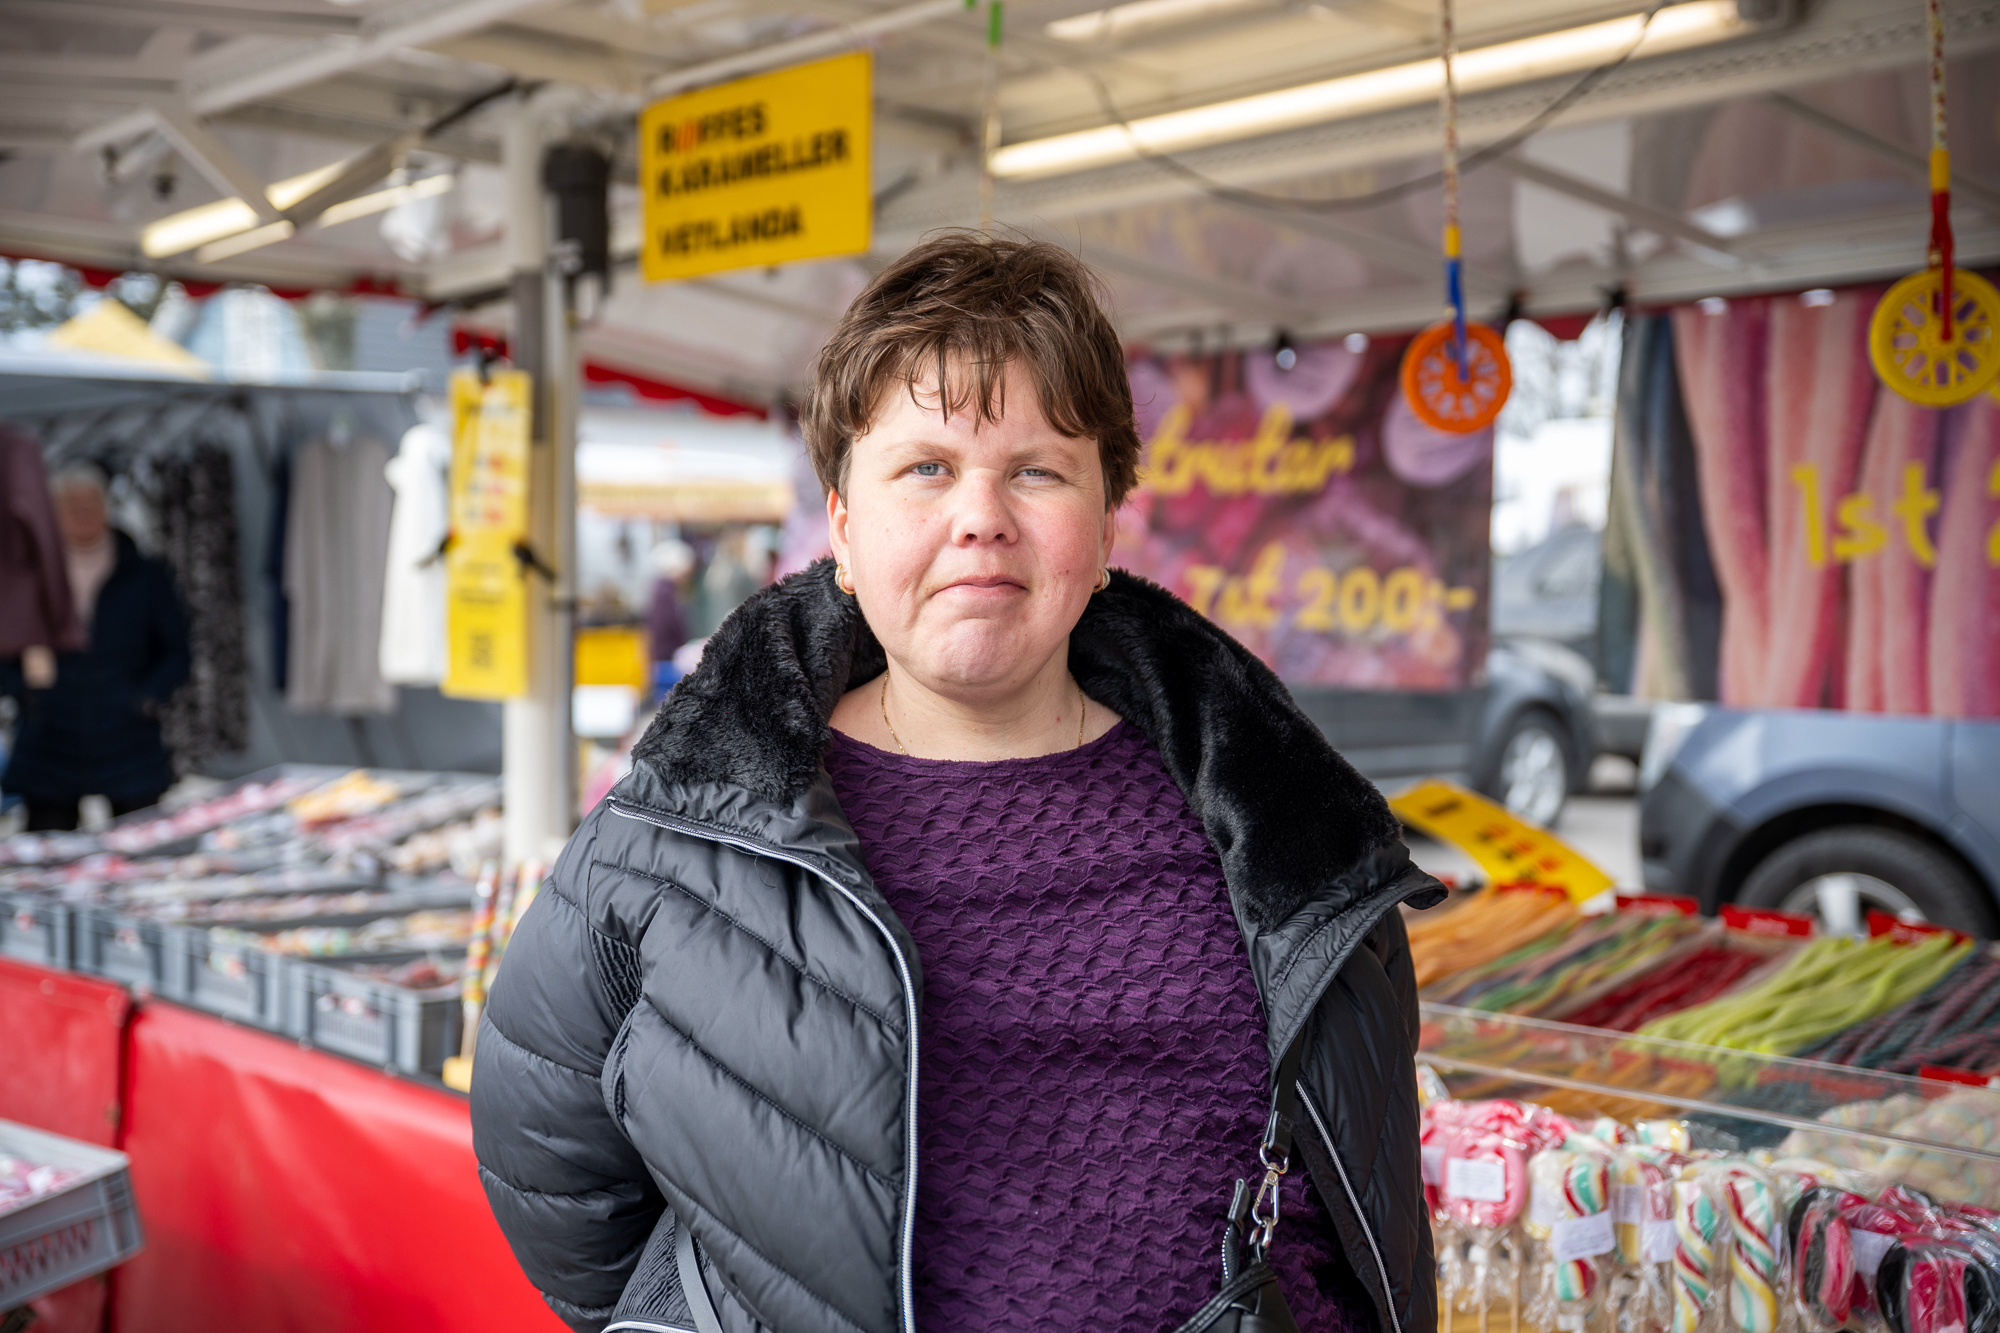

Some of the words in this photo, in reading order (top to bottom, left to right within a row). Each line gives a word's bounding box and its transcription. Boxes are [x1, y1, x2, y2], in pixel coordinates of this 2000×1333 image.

[657, 129, 849, 195] KARAMELLER
[660, 207, 804, 254] VETLANDA
[1141, 403, 1356, 495] trutar
